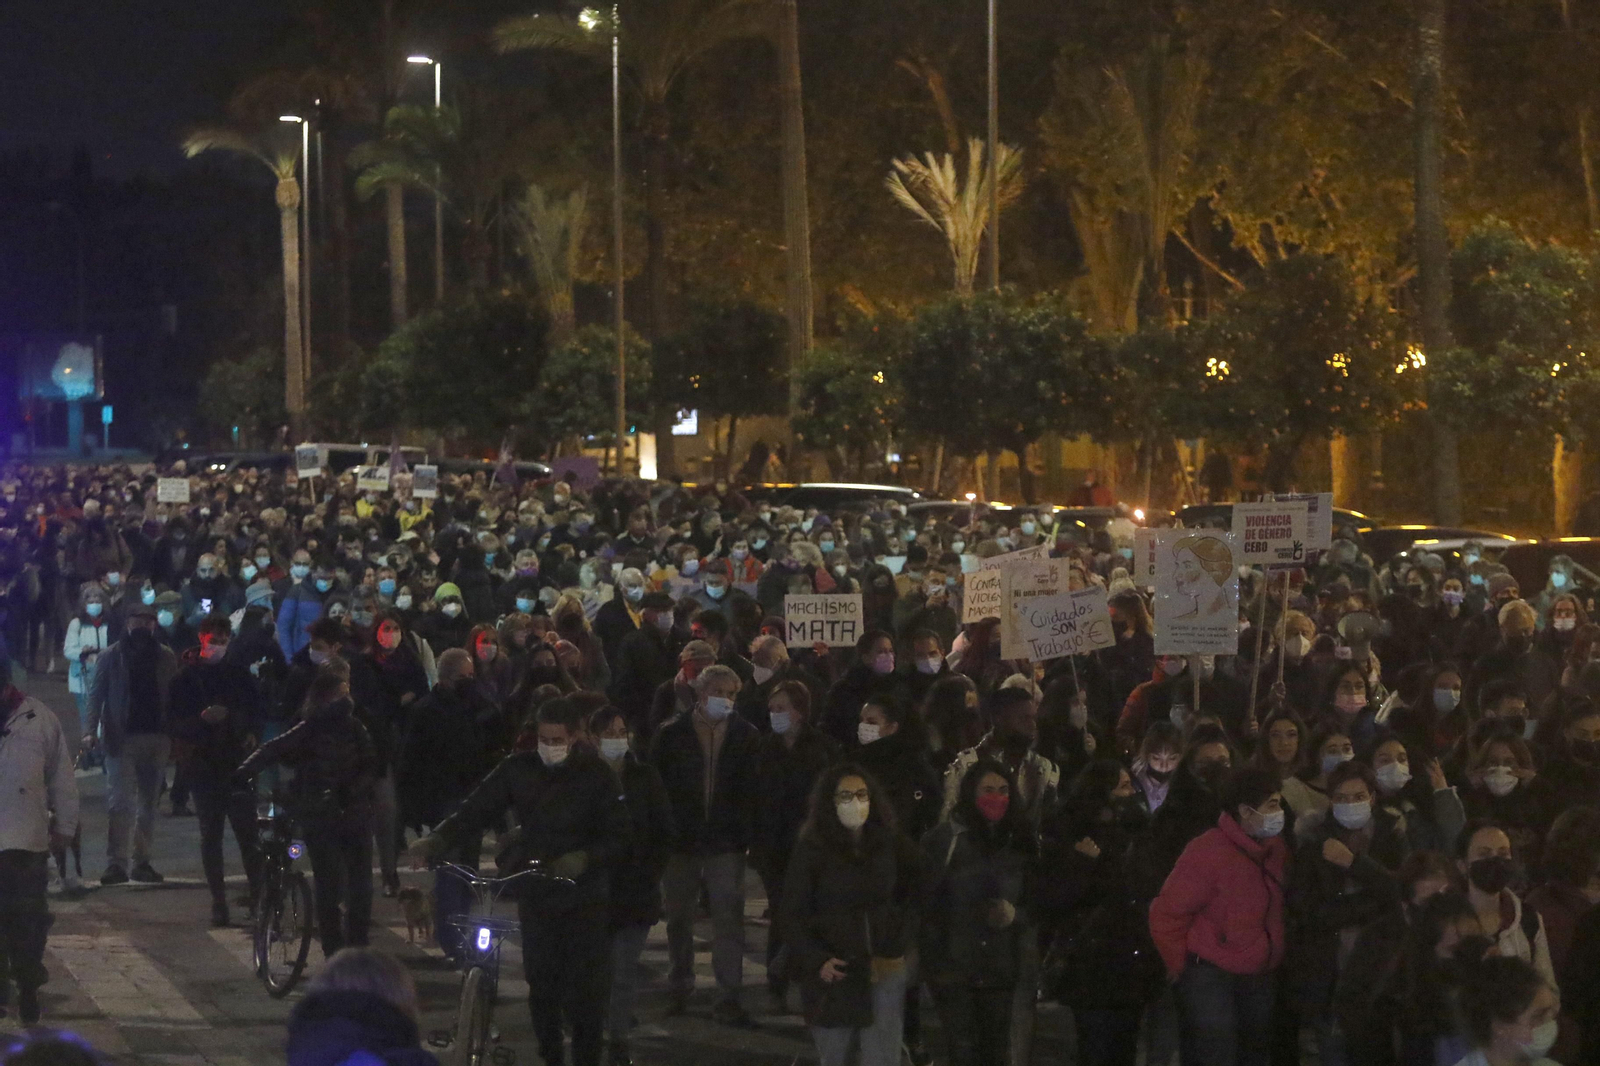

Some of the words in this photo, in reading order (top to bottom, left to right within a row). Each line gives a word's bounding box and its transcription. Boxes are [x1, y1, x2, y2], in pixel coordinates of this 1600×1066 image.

[1245, 514, 1292, 527] VIOLENCIA
[1244, 528, 1256, 540] DE
[1244, 541, 1268, 553] CERO
[1023, 589, 1037, 598] una
[1037, 588, 1058, 597] mujer
[787, 599, 857, 614] MACHISMO
[1030, 600, 1093, 629] Cuidados
[788, 620, 856, 642] MATA
[1050, 620, 1077, 637] SON
[1027, 635, 1084, 659] Trabajo
